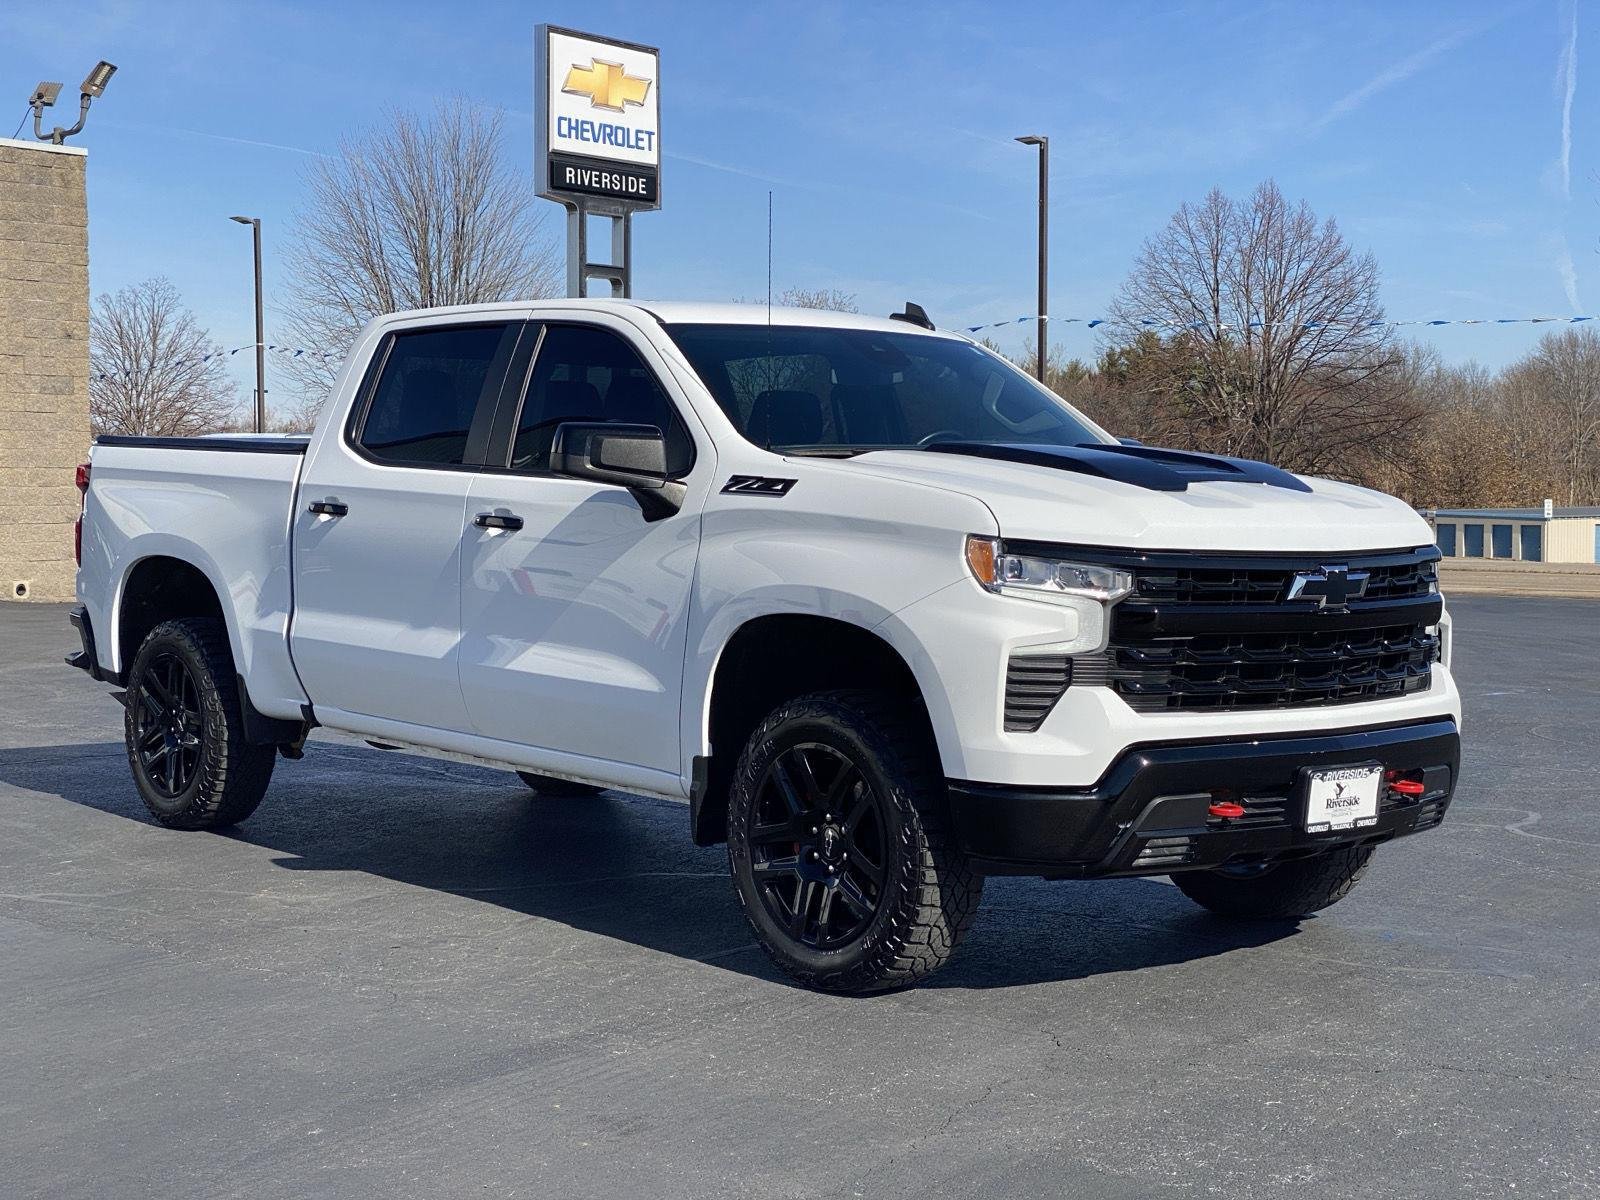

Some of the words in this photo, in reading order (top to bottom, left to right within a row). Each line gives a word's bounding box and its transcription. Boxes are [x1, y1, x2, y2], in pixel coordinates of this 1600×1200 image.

[557, 116, 656, 151] CHEVROLET
[565, 167, 647, 194] RIVERSIDE
[1326, 768, 1369, 781] RIVERSIDE
[1325, 795, 1361, 809] Riverside
